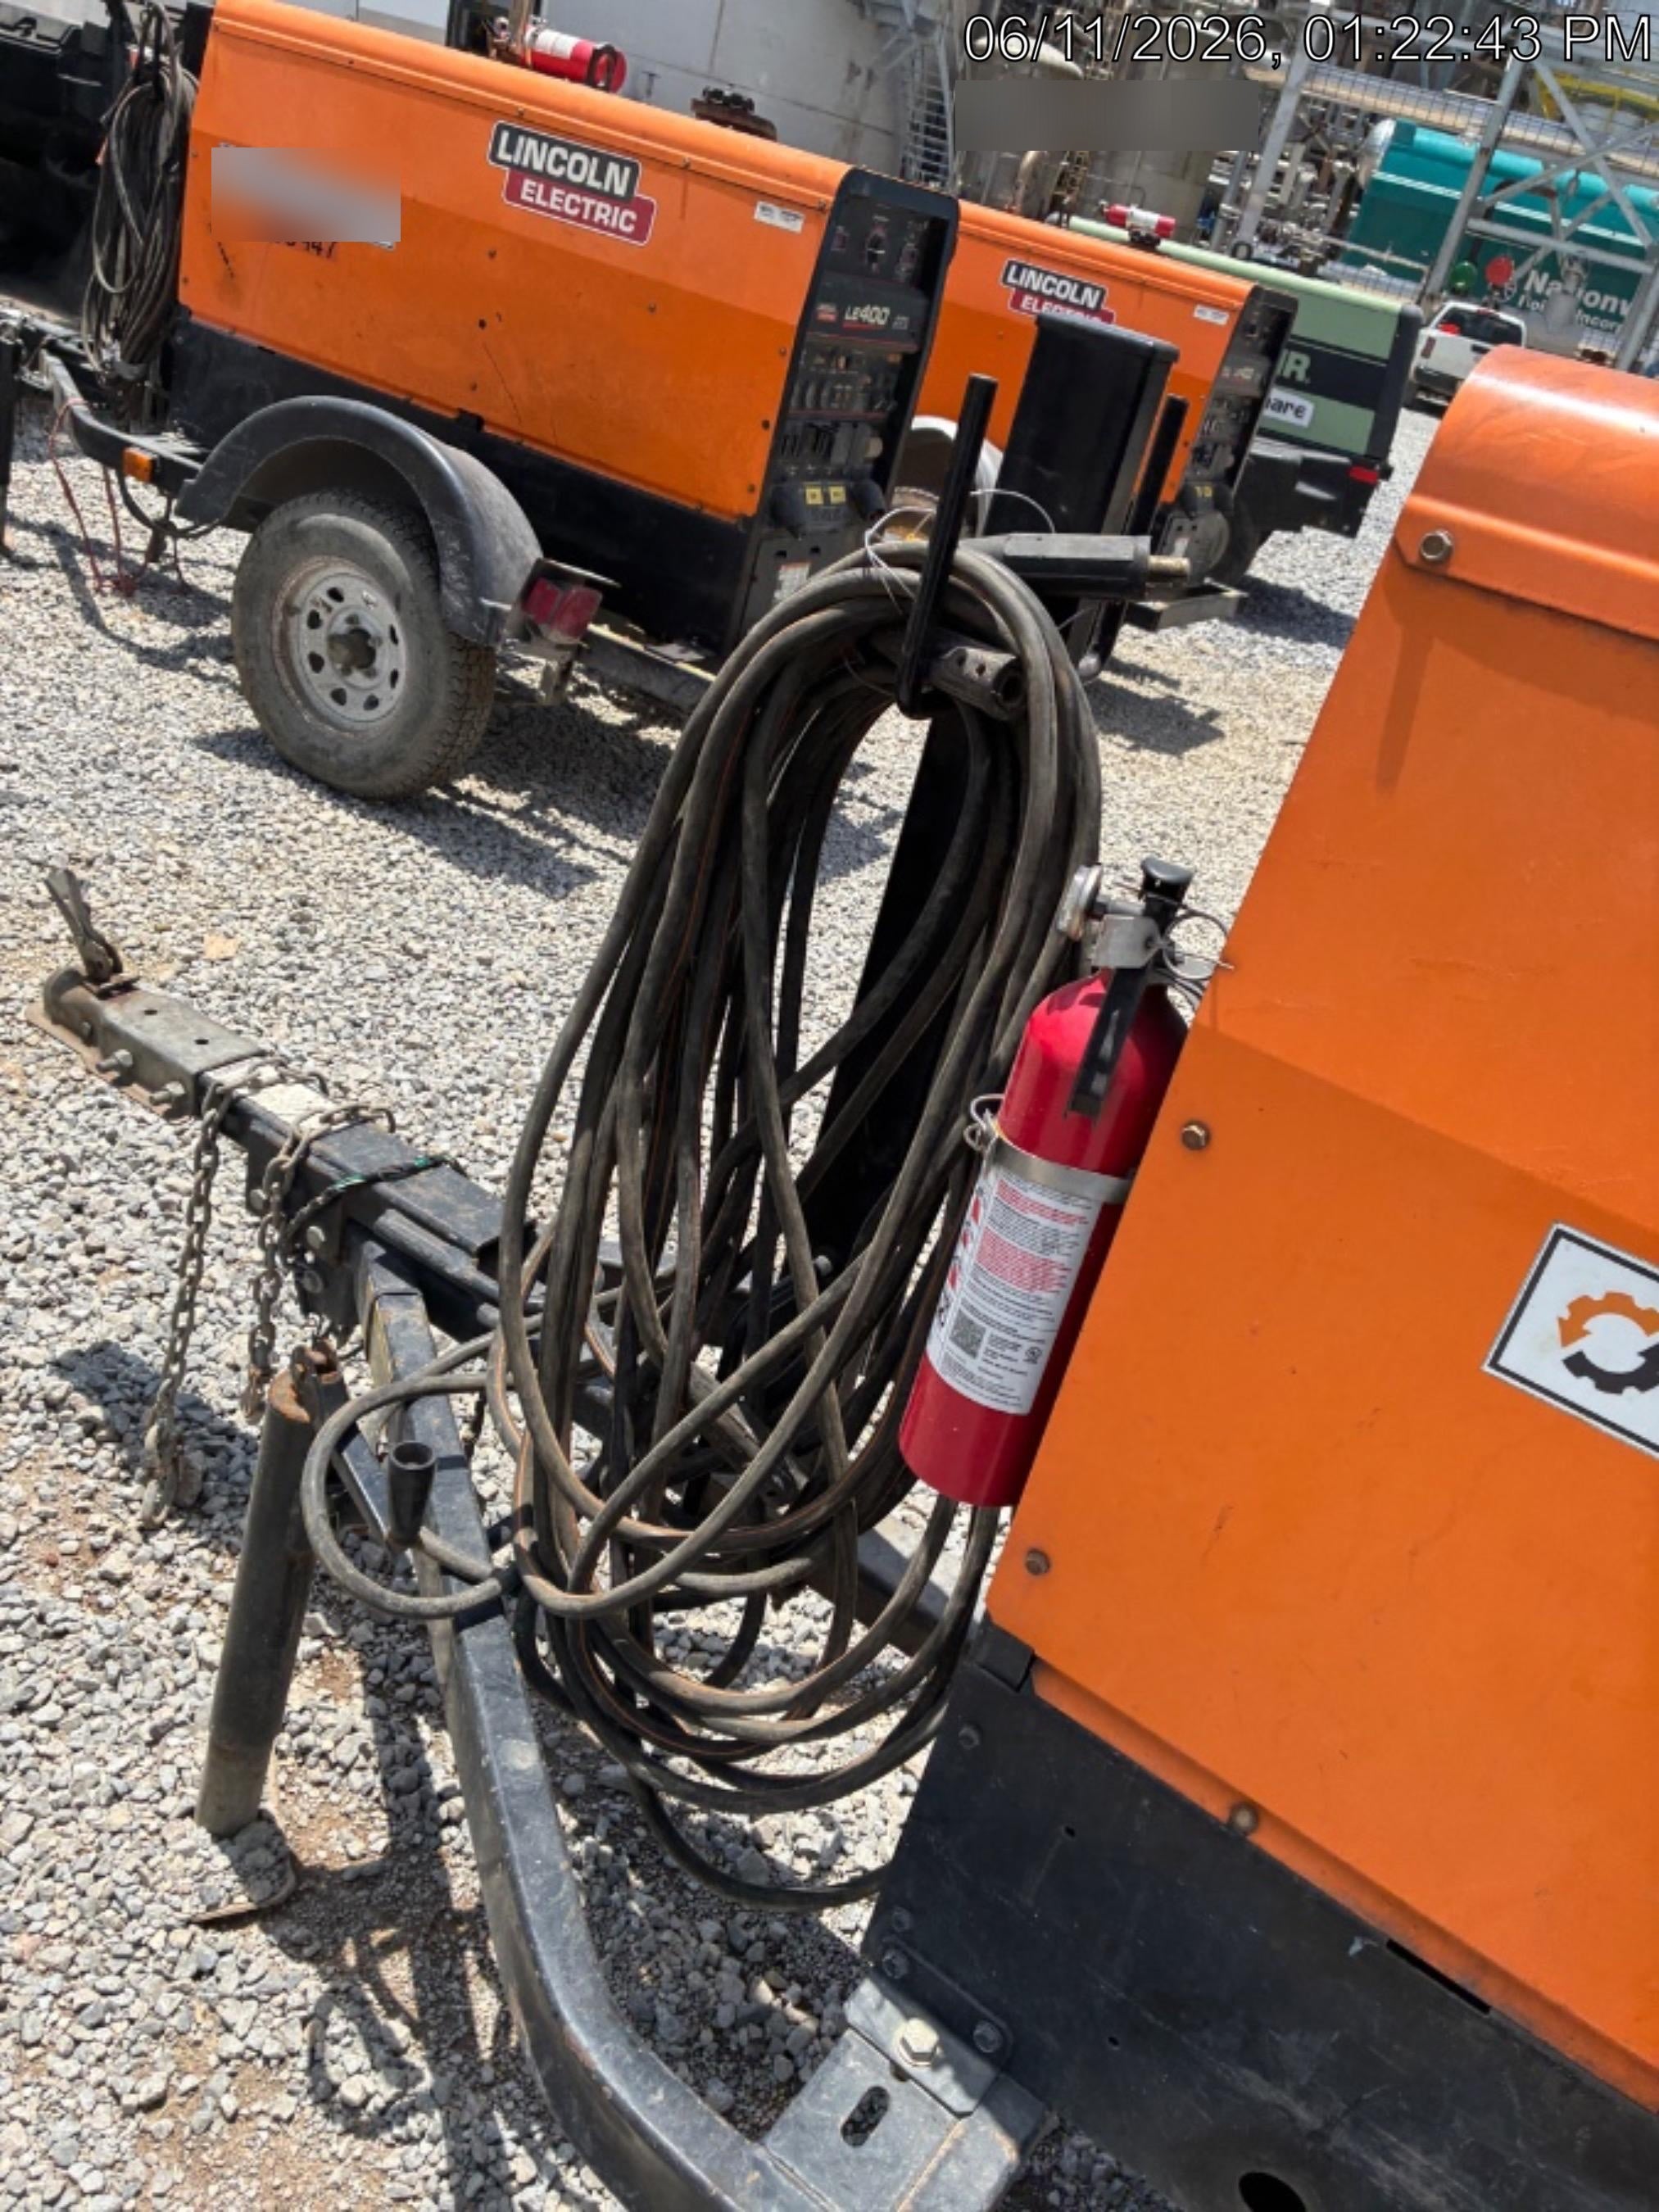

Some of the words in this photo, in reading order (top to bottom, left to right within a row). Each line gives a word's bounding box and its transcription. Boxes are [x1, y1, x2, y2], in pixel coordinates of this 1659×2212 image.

[496, 130, 632, 197] LINCOLN
[519, 178, 637, 233] ELECTRIC
[1006, 264, 1099, 309] LINCOLN
